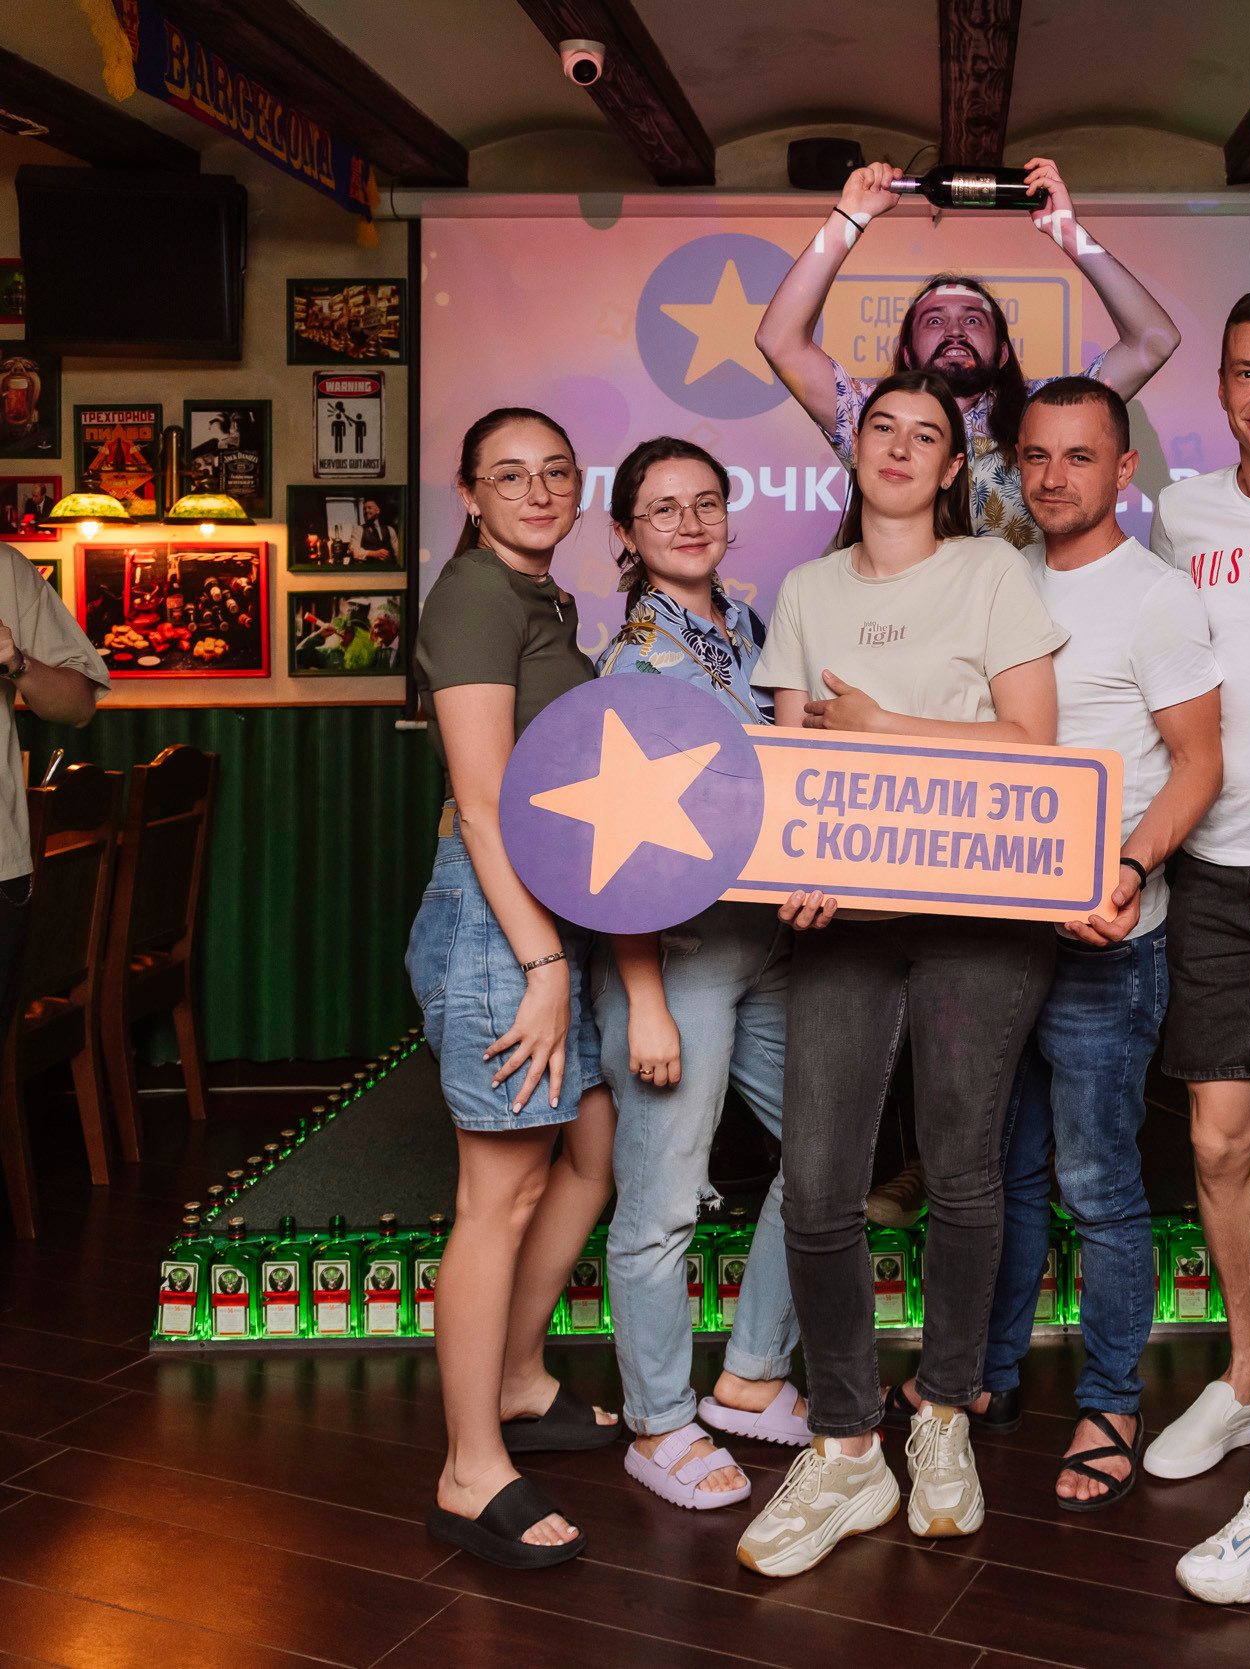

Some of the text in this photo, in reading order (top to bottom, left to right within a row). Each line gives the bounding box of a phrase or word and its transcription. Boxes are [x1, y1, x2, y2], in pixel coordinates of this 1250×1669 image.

[163, 18, 336, 191] BARCELONA
[325, 381, 372, 392] WARNING
[82, 410, 155, 423] ТРЕХГОРНОЕ
[319, 458, 380, 470] NERVOUS GUITARIST
[858, 624, 907, 648] light
[872, 624, 888, 632] the
[795, 768, 1059, 824] СДЕЛАЛИ ЭТО
[781, 819, 1065, 877] С КОЛЛЕГАМИ!
